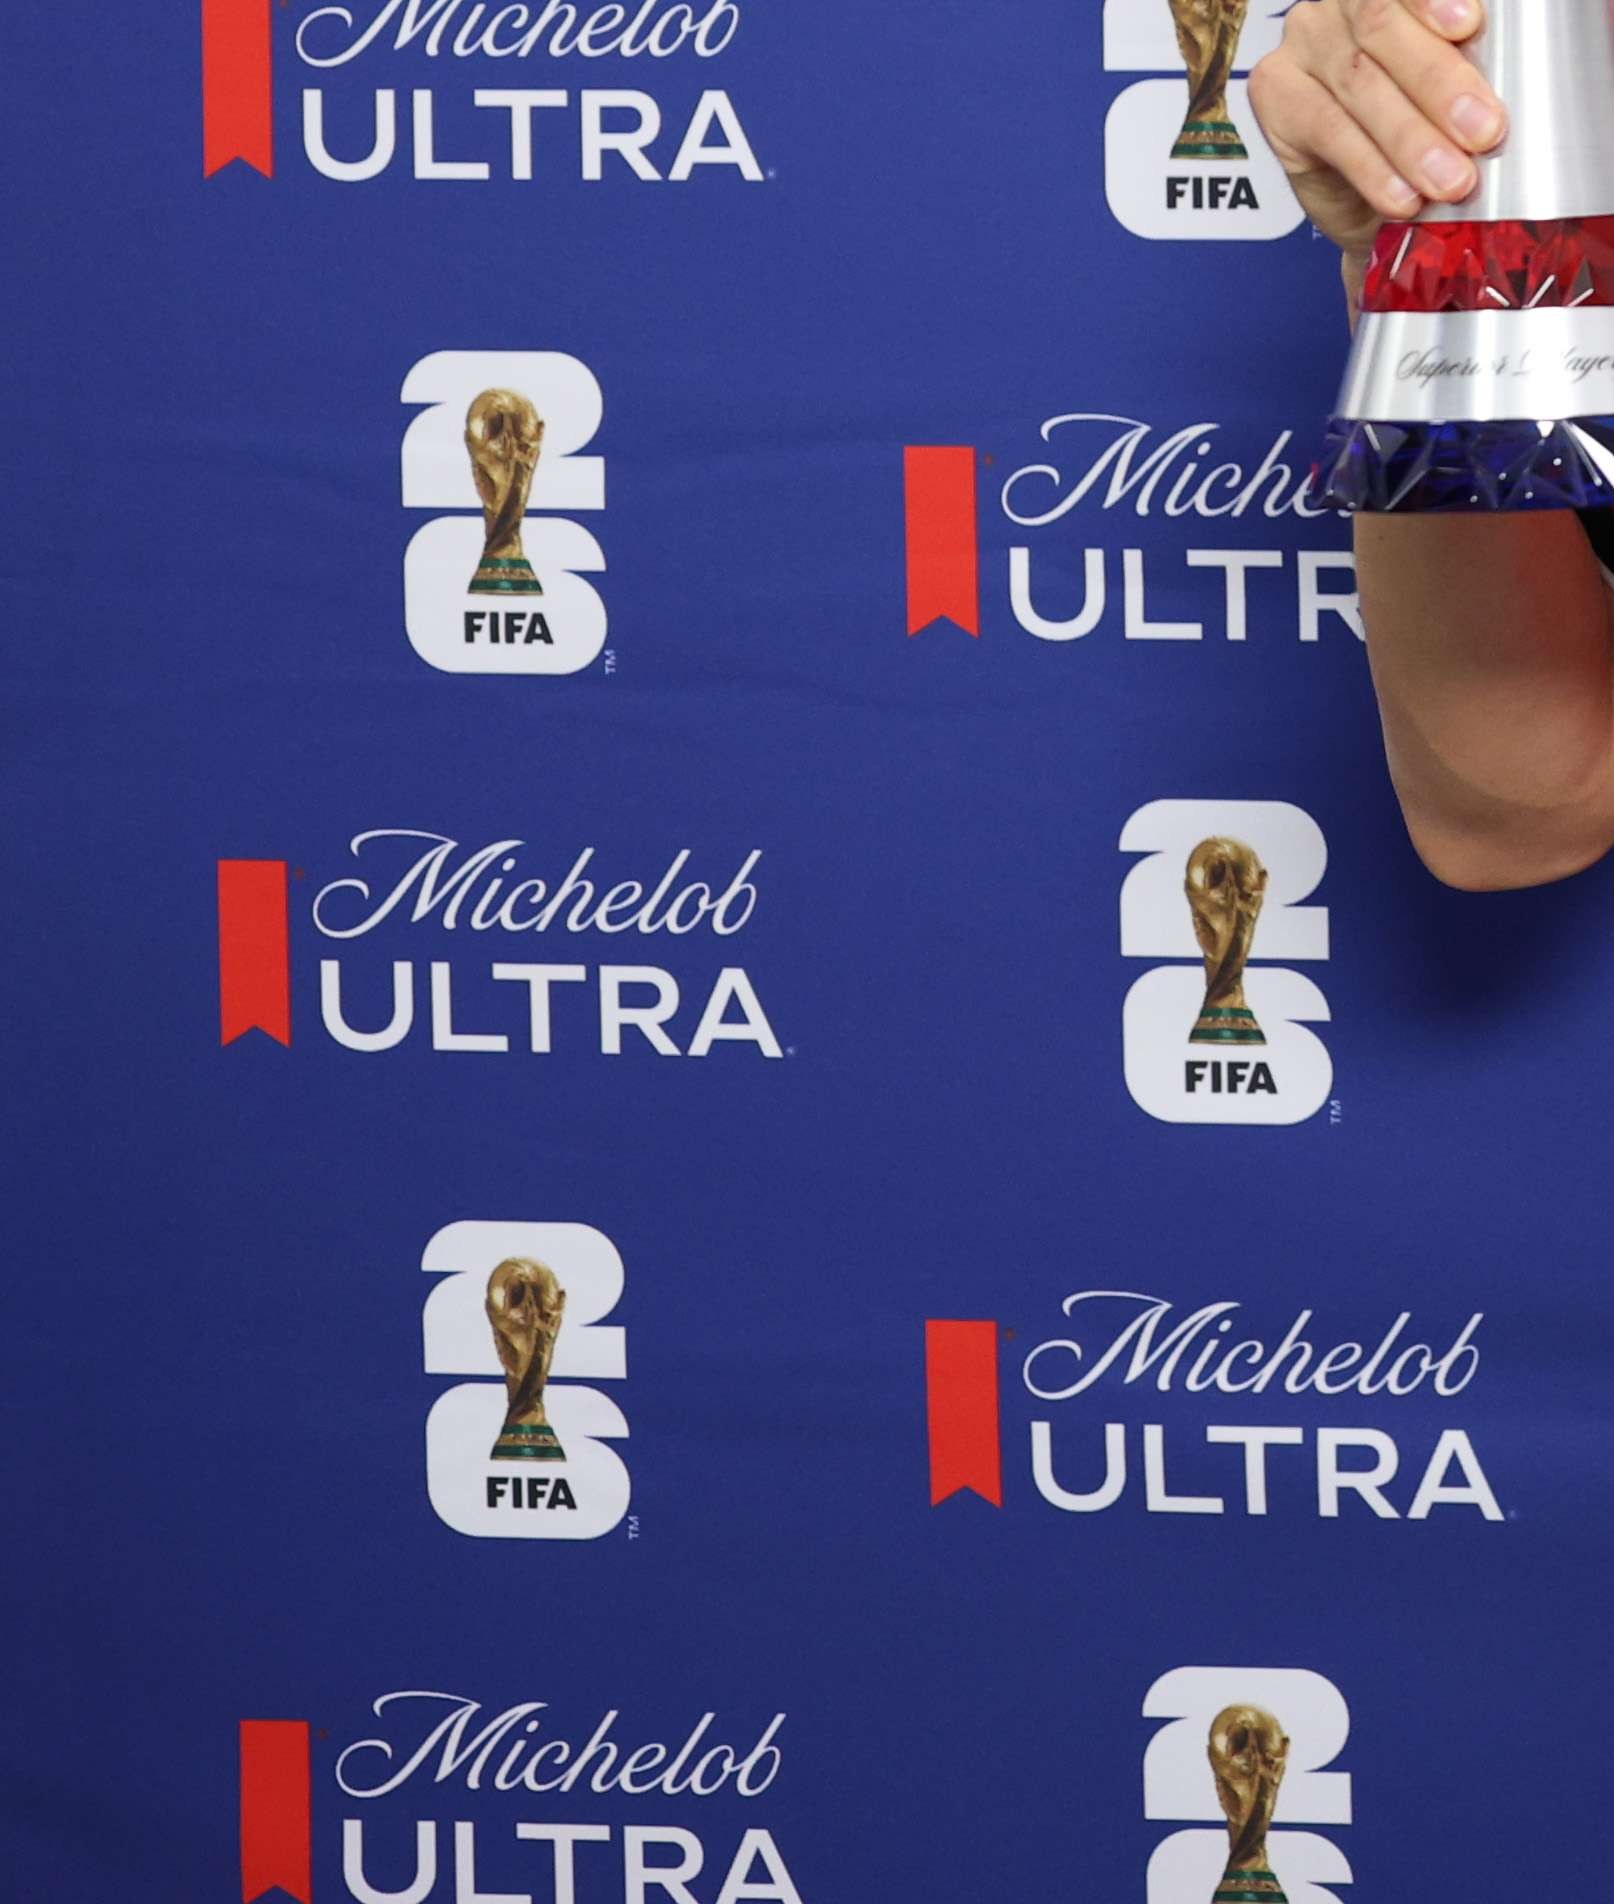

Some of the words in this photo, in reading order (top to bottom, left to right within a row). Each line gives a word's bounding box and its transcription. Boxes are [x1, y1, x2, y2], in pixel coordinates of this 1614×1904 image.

[304, 89, 763, 181] ULTRA
[1166, 176, 1260, 210] FIFA
[463, 611, 554, 645] FIFA
[1009, 547, 1367, 641] ULTR
[313, 829, 761, 937] Michelob
[321, 960, 782, 1057] ULTRA
[1184, 1060, 1278, 1095] FIFA
[1023, 1291, 1482, 1399] Michelob
[486, 1476, 578, 1510] FIFA
[1032, 1422, 1504, 1521] ULTRA
[336, 1691, 786, 1798] Michelob
[343, 1820, 804, 1904] ULTRA
